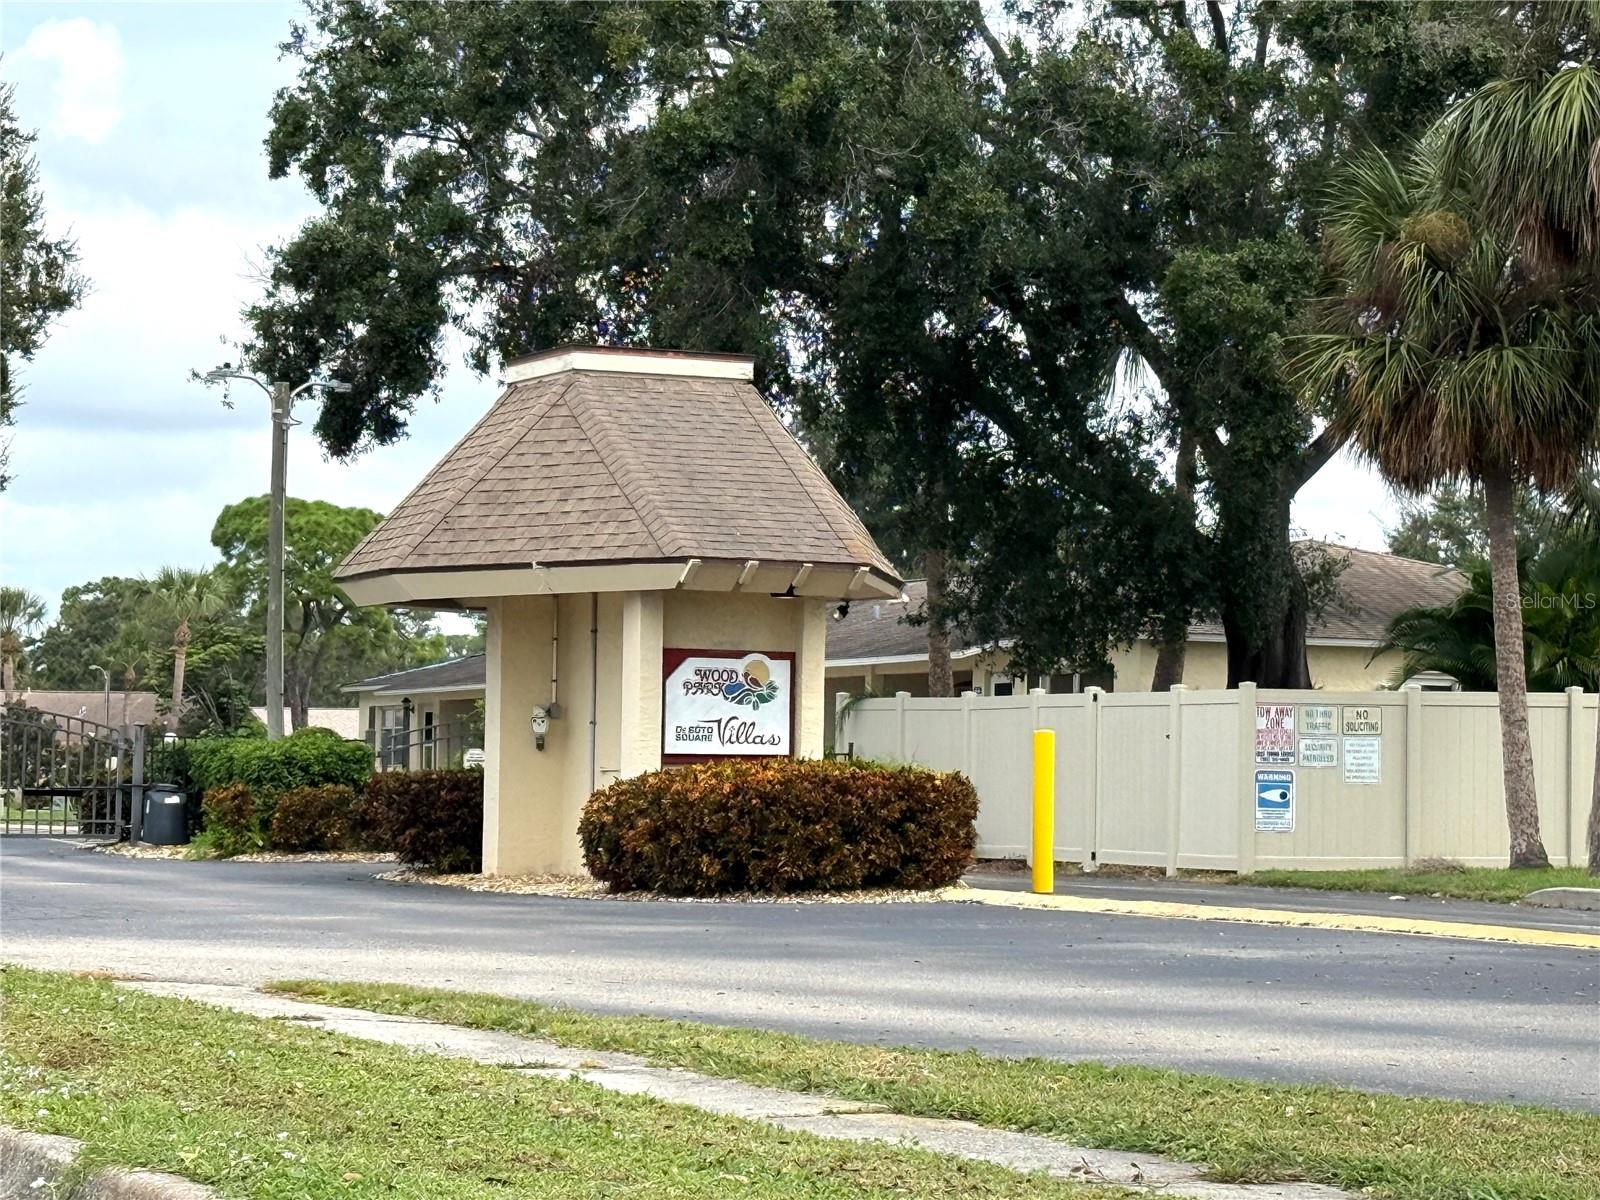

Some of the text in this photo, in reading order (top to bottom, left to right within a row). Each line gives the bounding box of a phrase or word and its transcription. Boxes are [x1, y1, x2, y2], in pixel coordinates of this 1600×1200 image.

[694, 668, 739, 683] WOOD
[1256, 706, 1293, 719] TOW AWAY
[1355, 709, 1369, 720] NO
[1265, 717, 1285, 729] ZONE
[1306, 722, 1332, 731] TRAFFIC
[1345, 721, 1379, 732] SOLICITING
[688, 725, 714, 734] SOTO
[697, 716, 781, 747] Villas
[675, 733, 713, 742] SQUARE
[1304, 743, 1332, 752] SECURITY
[1302, 754, 1334, 763] PATROLLED
[1257, 773, 1291, 781] WARNING
